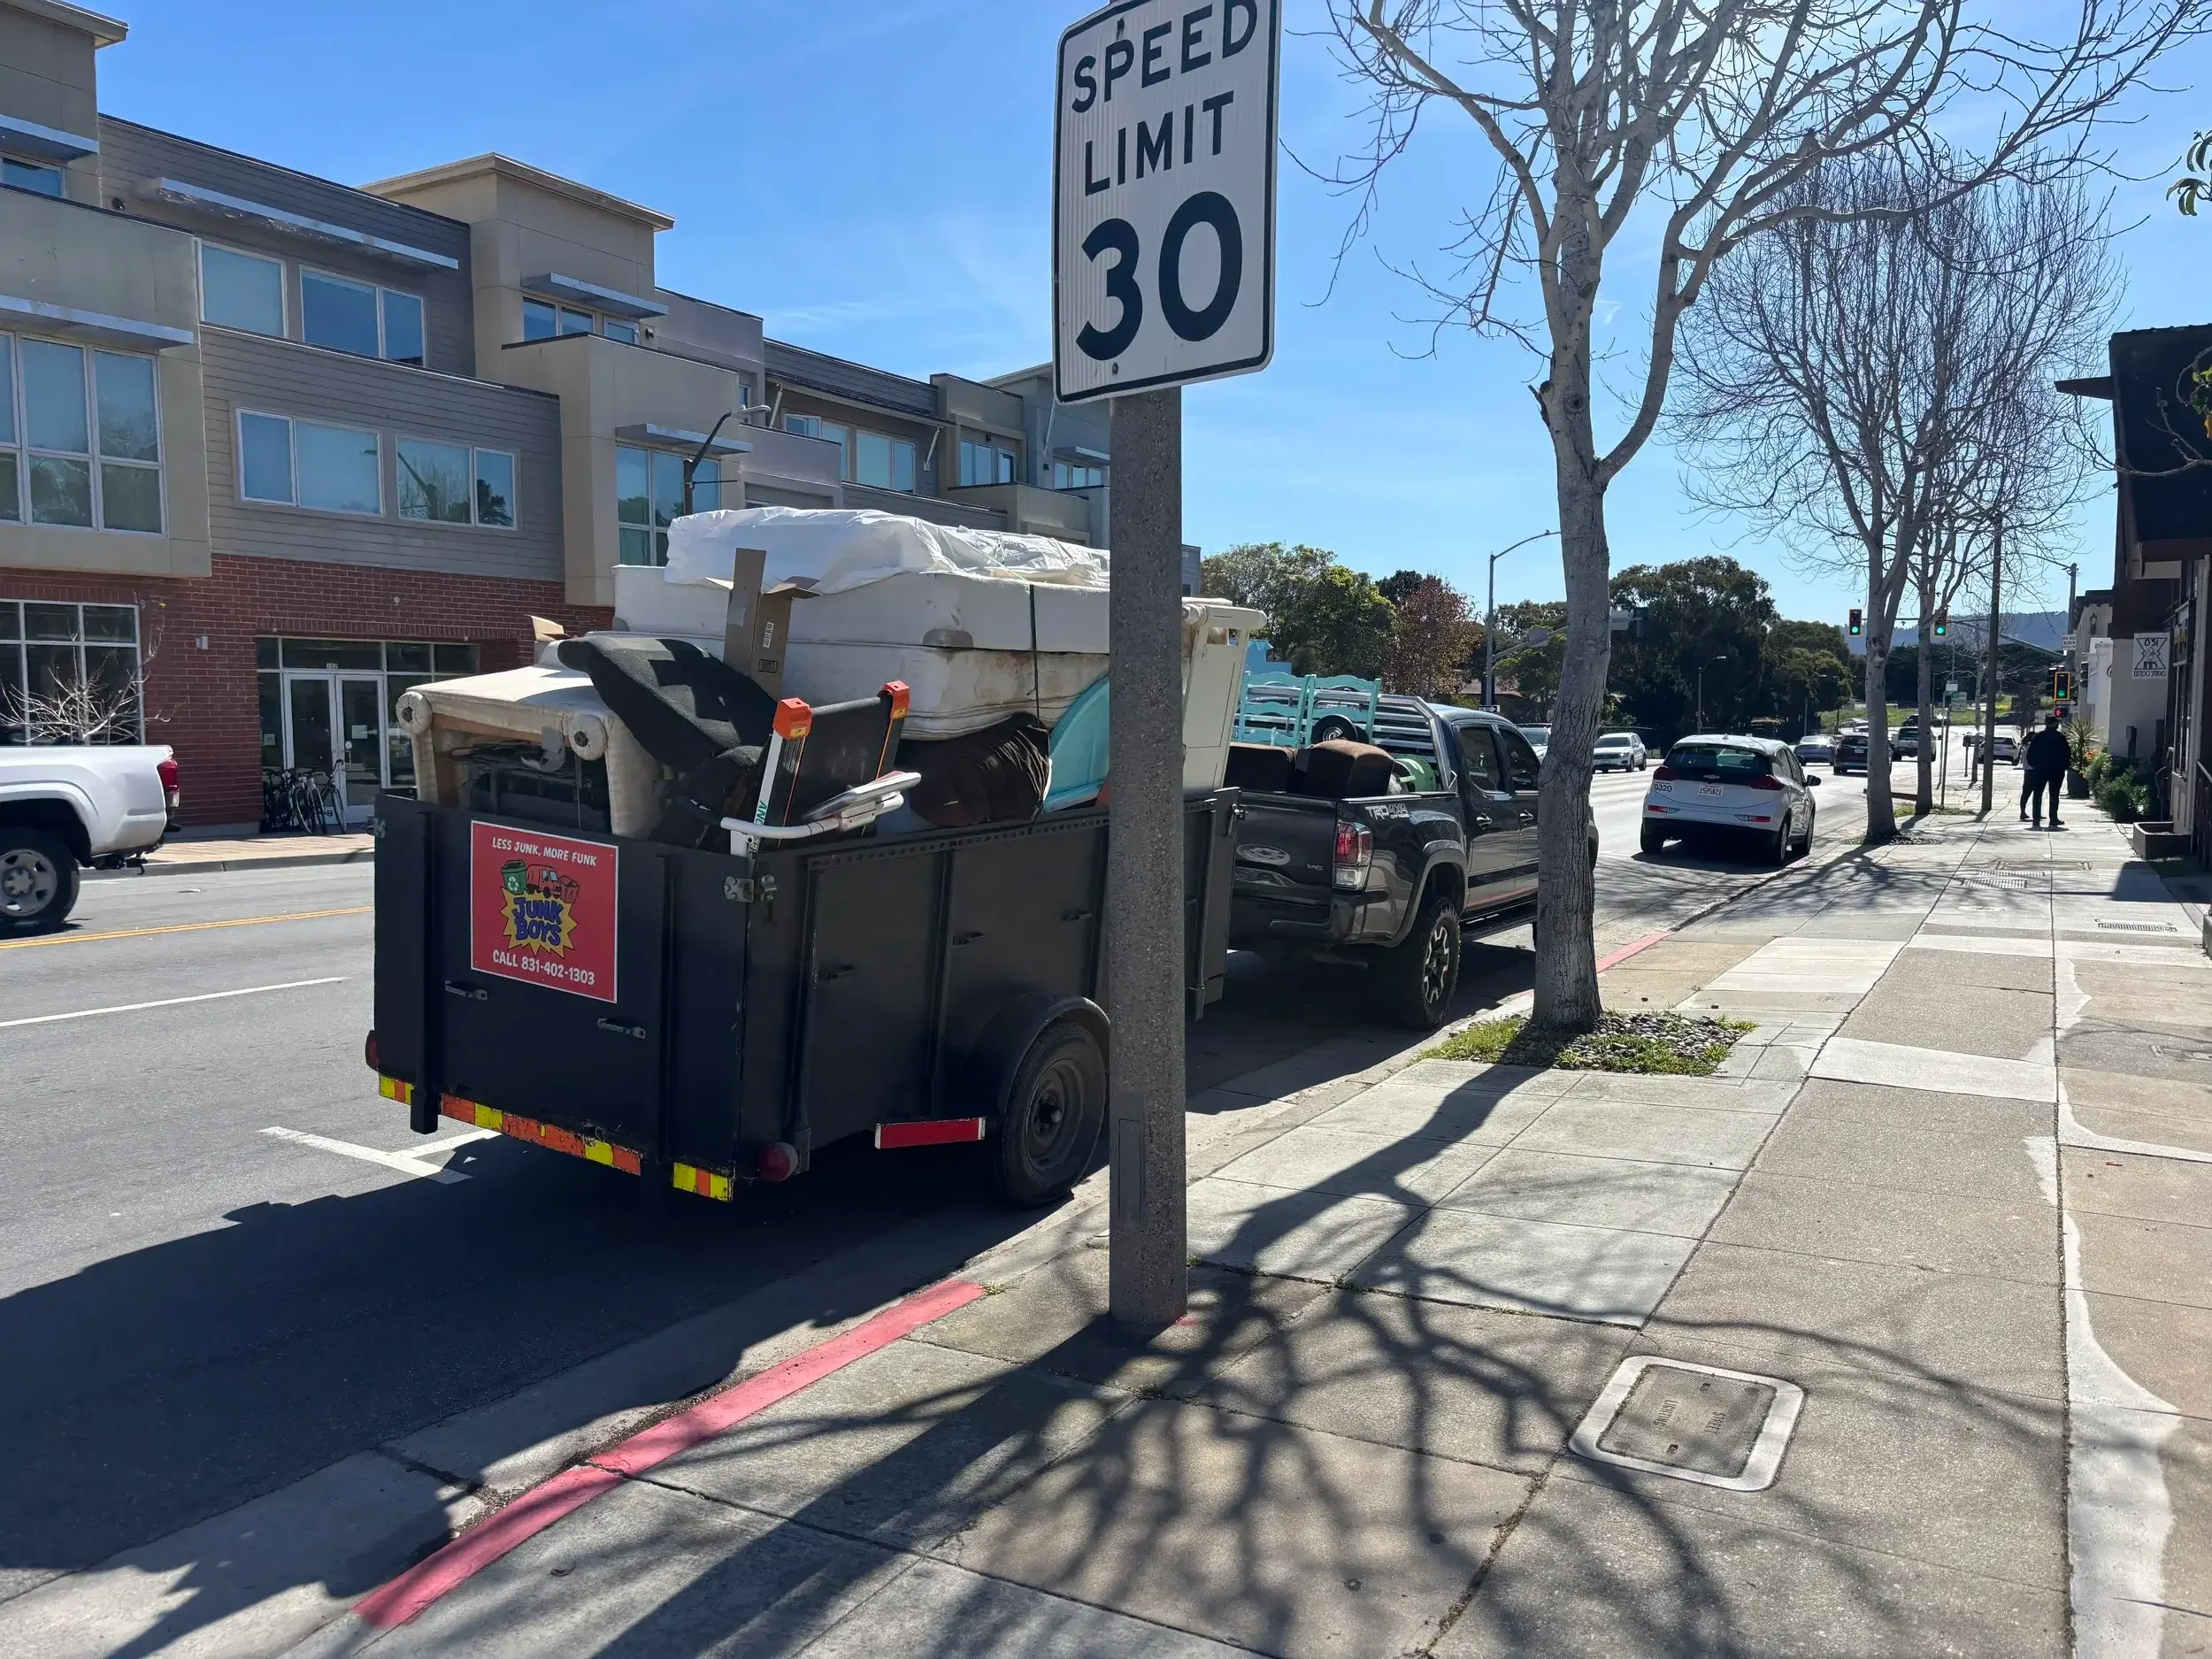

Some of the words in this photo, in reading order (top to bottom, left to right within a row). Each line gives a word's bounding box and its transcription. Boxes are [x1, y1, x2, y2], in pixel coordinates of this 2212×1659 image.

[1071, 0, 1257, 113] SPEED
[1085, 90, 1234, 196] LIMIT
[1076, 191, 1243, 361] 30
[1654, 783, 1672, 793] 0320
[1365, 805, 1389, 820] TRD
[492, 837, 512, 851] LESS
[514, 841, 542, 856] JUNK,
[543, 846, 569, 862] MORE
[572, 851, 597, 867] FUNK
[512, 897, 563, 925] JUNK
[515, 918, 562, 946] BOYS
[492, 949, 518, 968] CALL
[521, 956, 595, 986] 831-402-1303
